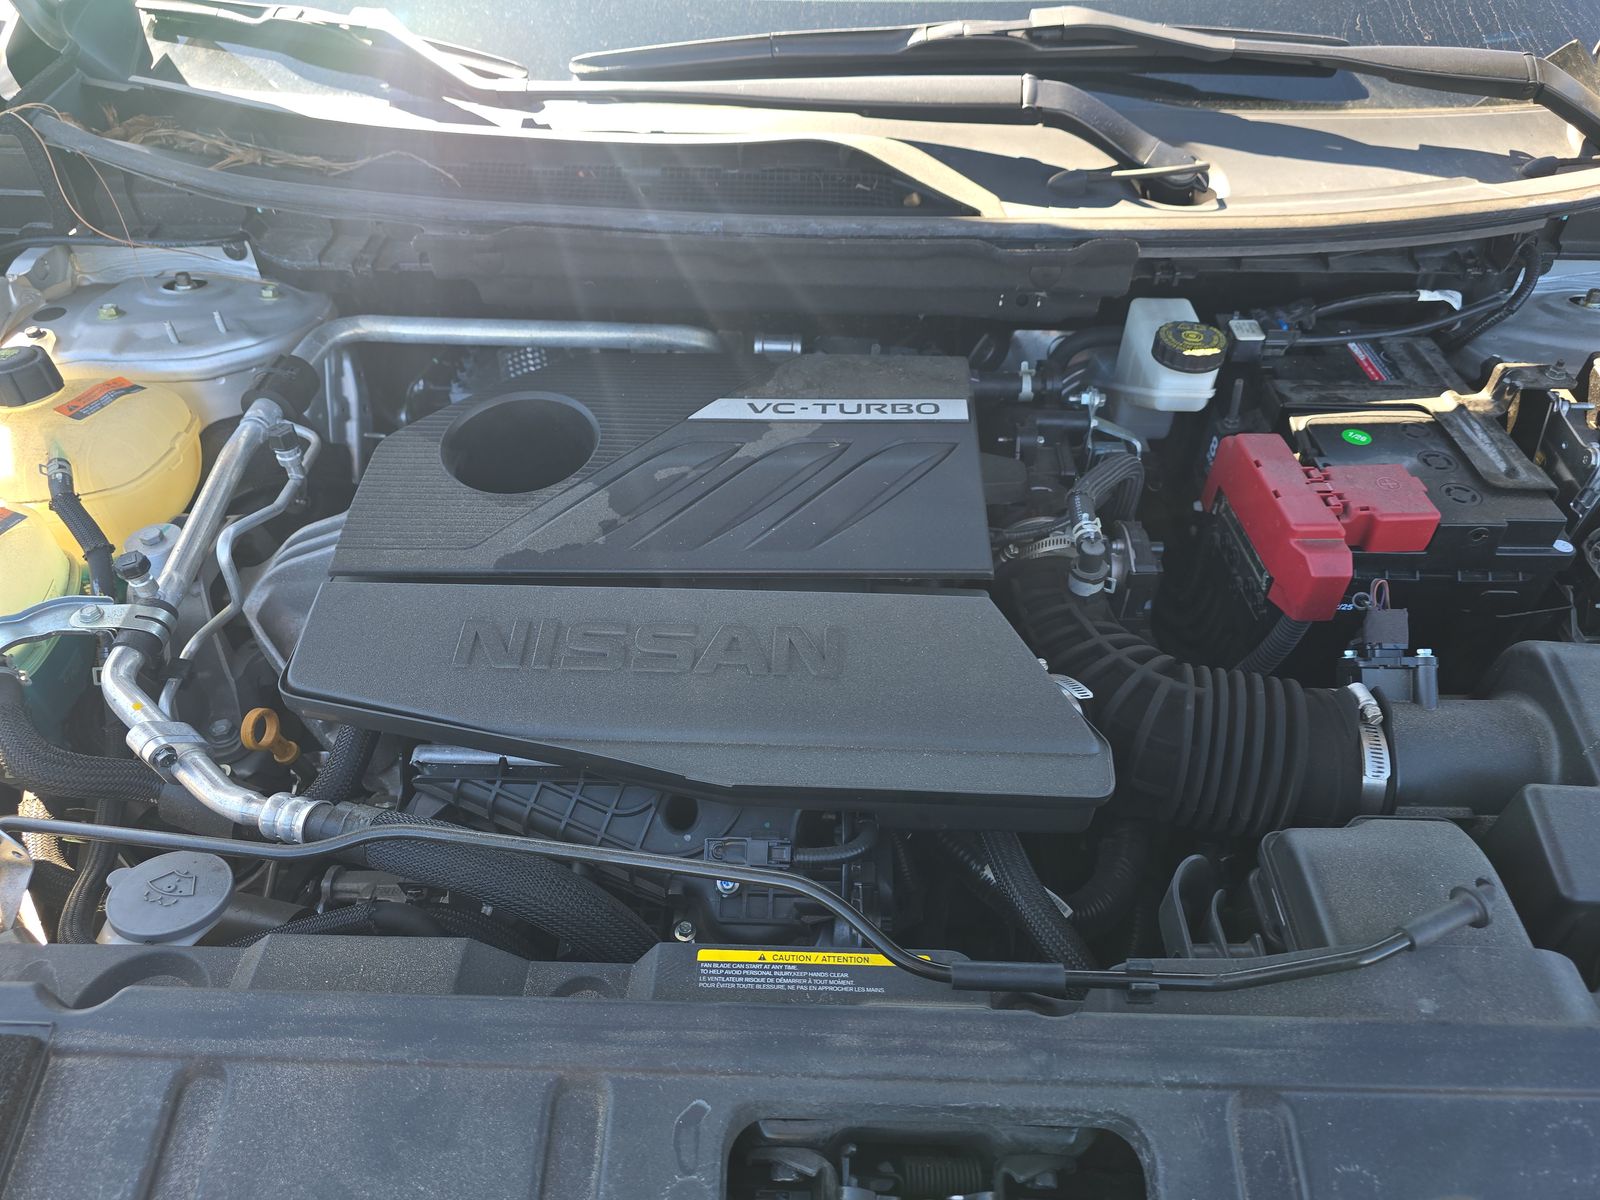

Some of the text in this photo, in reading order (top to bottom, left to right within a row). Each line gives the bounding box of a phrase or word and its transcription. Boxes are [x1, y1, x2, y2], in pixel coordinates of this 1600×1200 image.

[747, 402, 940, 415] VC-TURBO
[451, 616, 843, 678] NISSAN
[772, 954, 811, 962] CAUTION
[821, 955, 870, 964] ATTENTION
